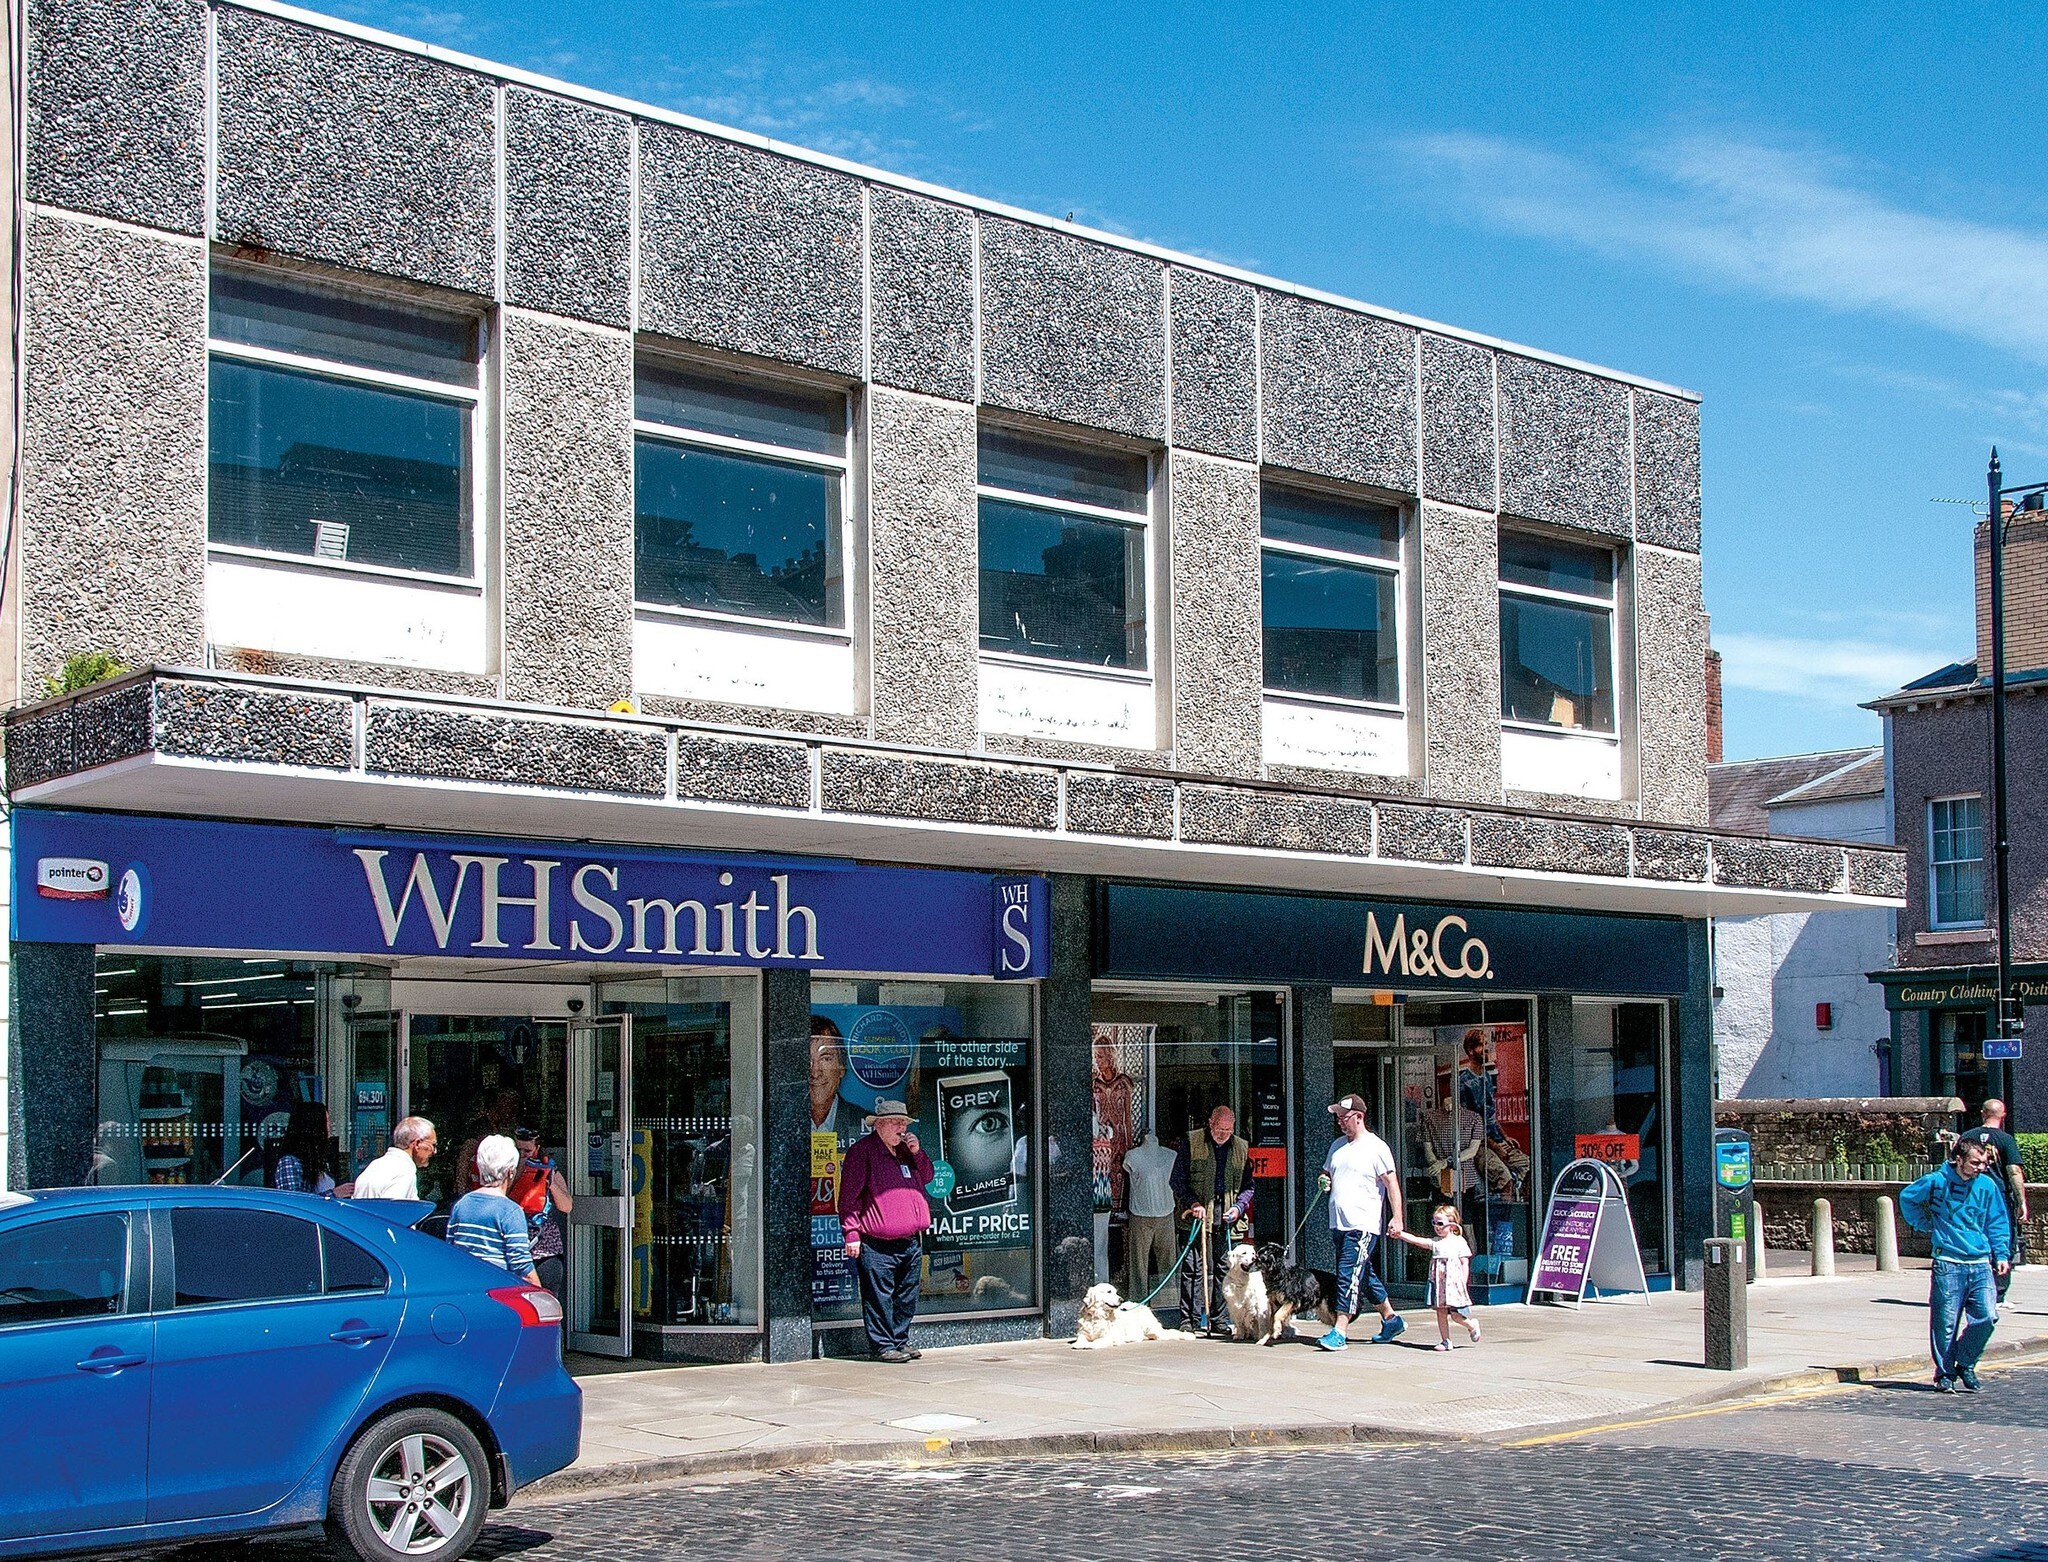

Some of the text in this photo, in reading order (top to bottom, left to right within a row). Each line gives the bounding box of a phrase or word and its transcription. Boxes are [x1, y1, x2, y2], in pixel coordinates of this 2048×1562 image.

[49, 867, 85, 879] pointer
[1001, 884, 1028, 904] WH
[353, 849, 825, 959] WHSmith
[1002, 904, 1031, 972] S
[1362, 911, 1494, 980] M&Co.
[1901, 987, 1947, 1004] Country
[1950, 984, 2000, 1001] Clothing
[852, 1014, 882, 1043] RICHARD
[935, 1040, 1019, 1053] The other side
[938, 1054, 1015, 1068] of the story...
[861, 1069, 900, 1079] WHSmith
[950, 1089, 1001, 1109] GREY
[1262, 1103, 1280, 1111] Vacancy
[814, 1148, 833, 1156] HALF
[1580, 1143, 1625, 1159] 30% OFF
[934, 1177, 944, 1187] 18
[956, 1185, 963, 1195] E
[965, 1183, 972, 1193] L
[973, 1177, 1007, 1192] JAMES
[1574, 1210, 1596, 1219] COLLECT
[925, 1213, 1030, 1235] HALF PRICE
[811, 1233, 845, 1246] COLLE
[936, 1234, 954, 1242] when
[955, 1234, 968, 1243] you
[969, 1232, 1000, 1242] pre-order
[1001, 1231, 1011, 1239] for
[1012, 1230, 1020, 1238] £2
[816, 1248, 849, 1262] FREE
[1550, 1244, 1581, 1261] FREE
[821, 1262, 843, 1270] Delivery
[1568, 1268, 1583, 1276] STORE
[1569, 1261, 1585, 1269] STORE
